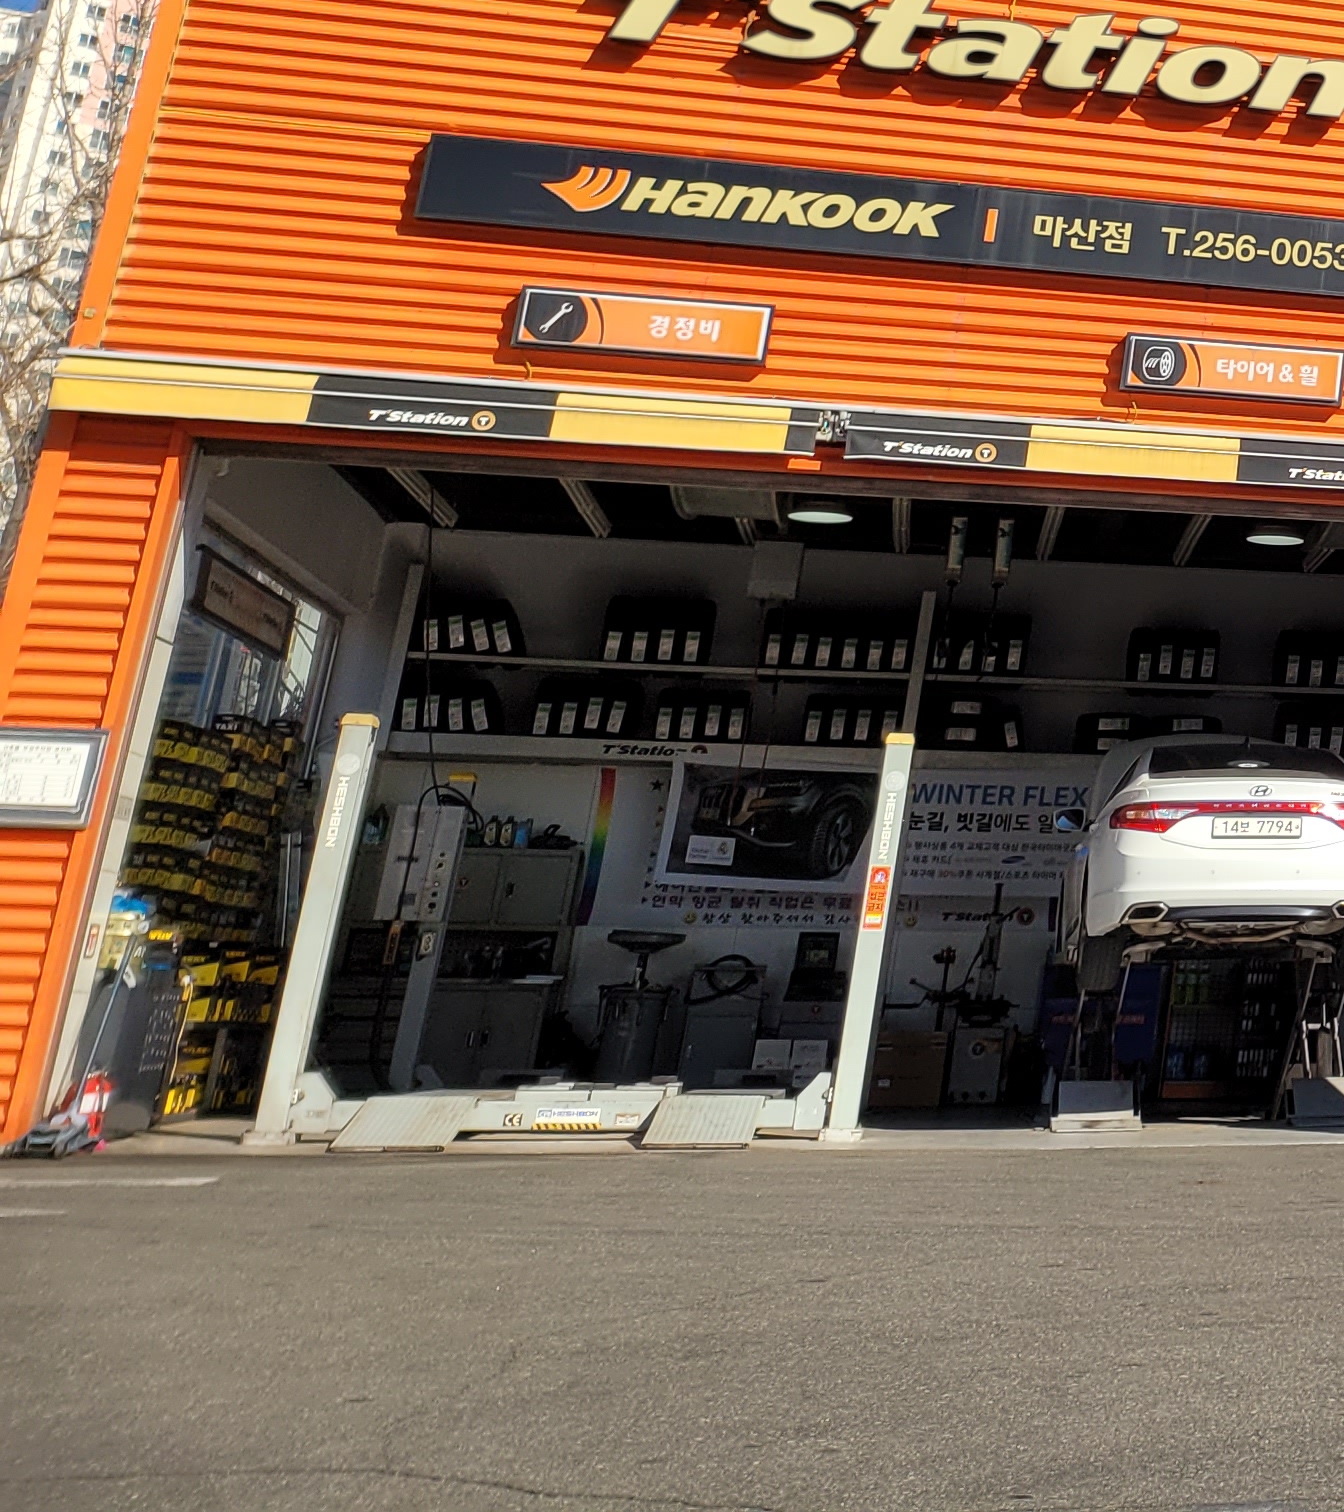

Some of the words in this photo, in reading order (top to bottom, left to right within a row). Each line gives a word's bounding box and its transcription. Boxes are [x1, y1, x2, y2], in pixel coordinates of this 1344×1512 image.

[1032, 212, 1133, 256] 마산점
[648, 315, 722, 343] 경정비
[1215, 358, 1275, 384] 타이어
[1299, 365, 1319, 387] 휠
[369, 409, 470, 427] T'Station
[883, 441, 973, 458] T'Station
[602, 744, 687, 757] T'Statio
[912, 783, 1014, 806] WINTER
[1023, 785, 1089, 807] FLEX
[909, 811, 948, 833] 눈길,
[956, 812, 1031, 833] 빗길에도
[1256, 820, 1293, 834] 7794
